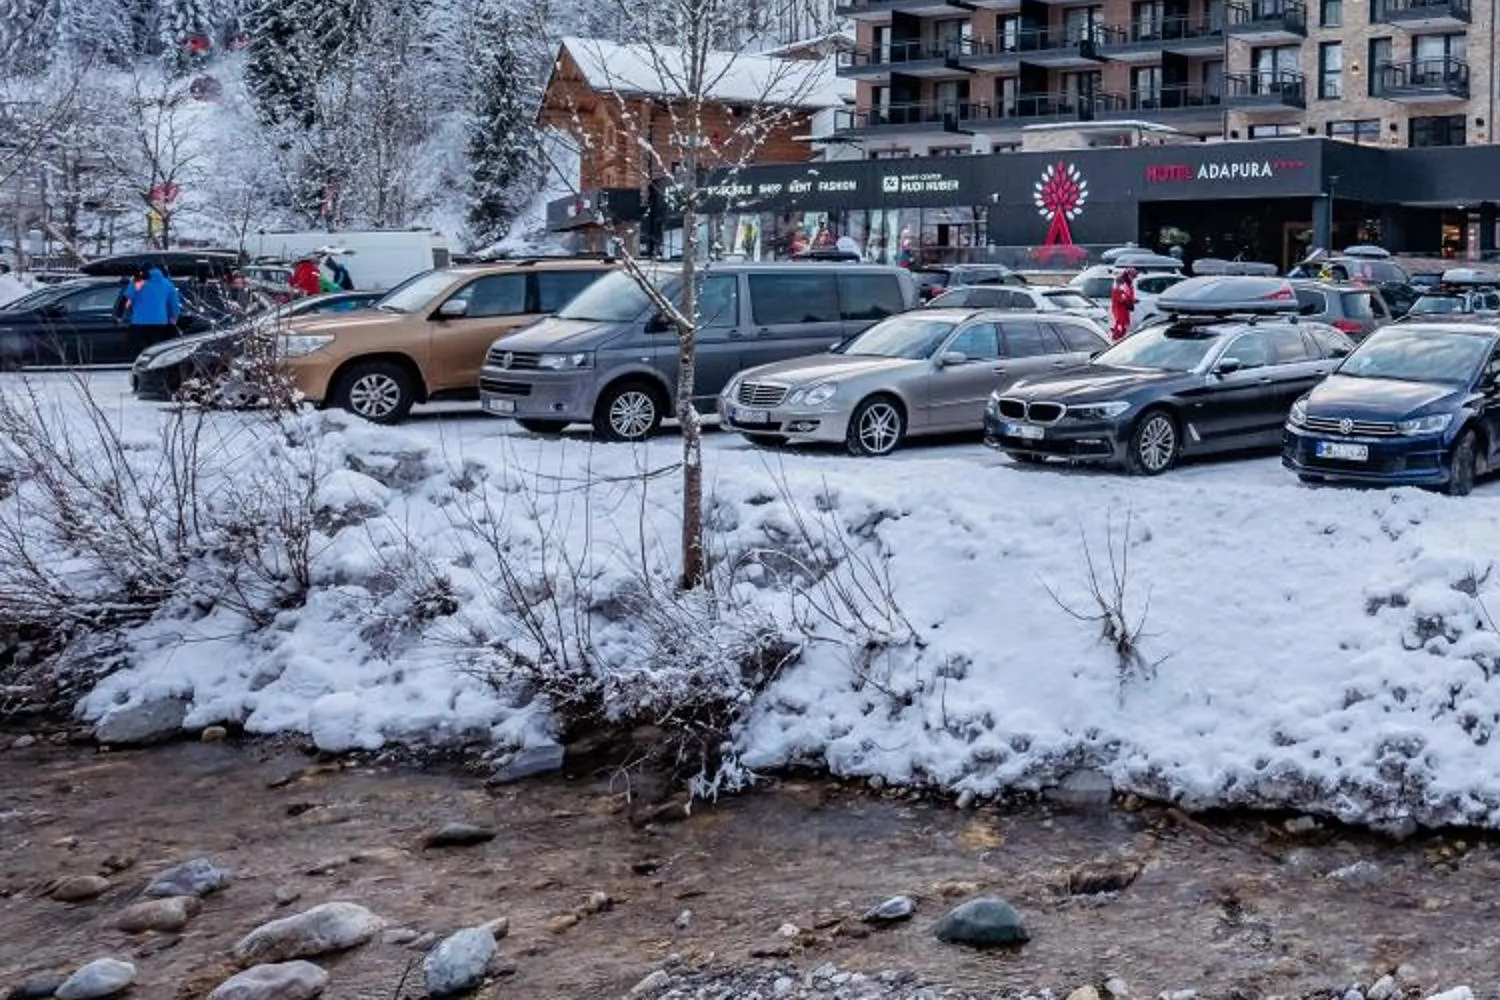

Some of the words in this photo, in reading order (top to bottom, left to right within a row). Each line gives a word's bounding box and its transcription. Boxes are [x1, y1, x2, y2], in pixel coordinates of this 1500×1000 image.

[1147, 165, 1193, 181] HOTEL
[1197, 160, 1273, 180] ADAPURA
[818, 180, 857, 192] FASHION
[901, 181, 925, 192] RUDI
